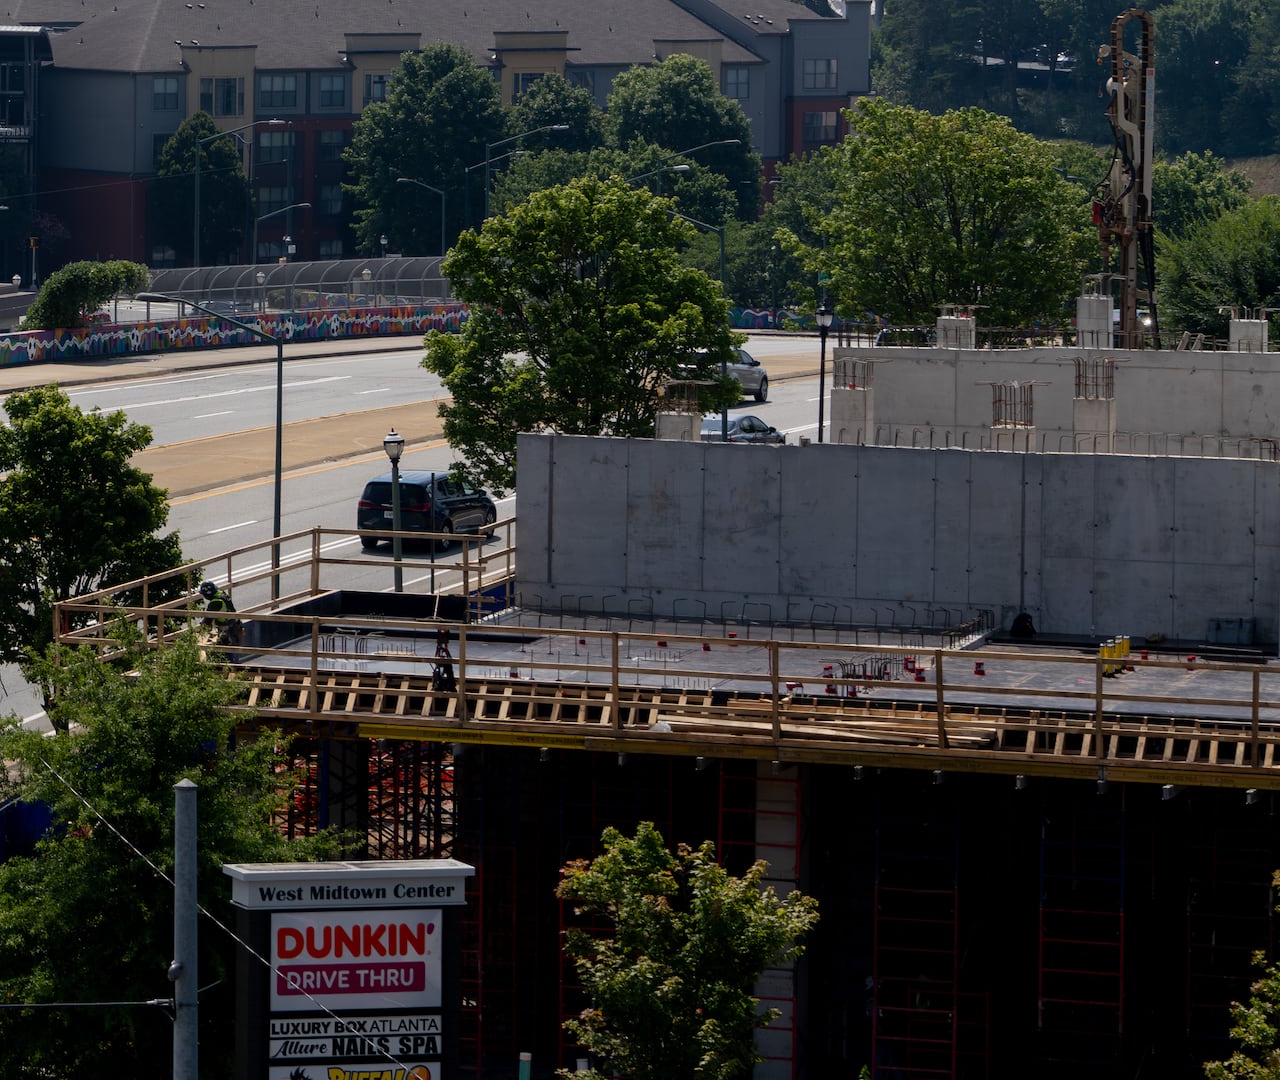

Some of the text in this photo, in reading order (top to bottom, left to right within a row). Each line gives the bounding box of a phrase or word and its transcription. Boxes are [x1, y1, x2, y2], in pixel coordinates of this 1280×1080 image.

[259, 883, 455, 902] West Midtown Center
[277, 922, 435, 959] DUNKIN'
[286, 968, 414, 989] DRIVE THRU
[271, 1018, 439, 1035] LUXURY BOX ATLANTA
[273, 1036, 439, 1058] Allure NAILS SPA
